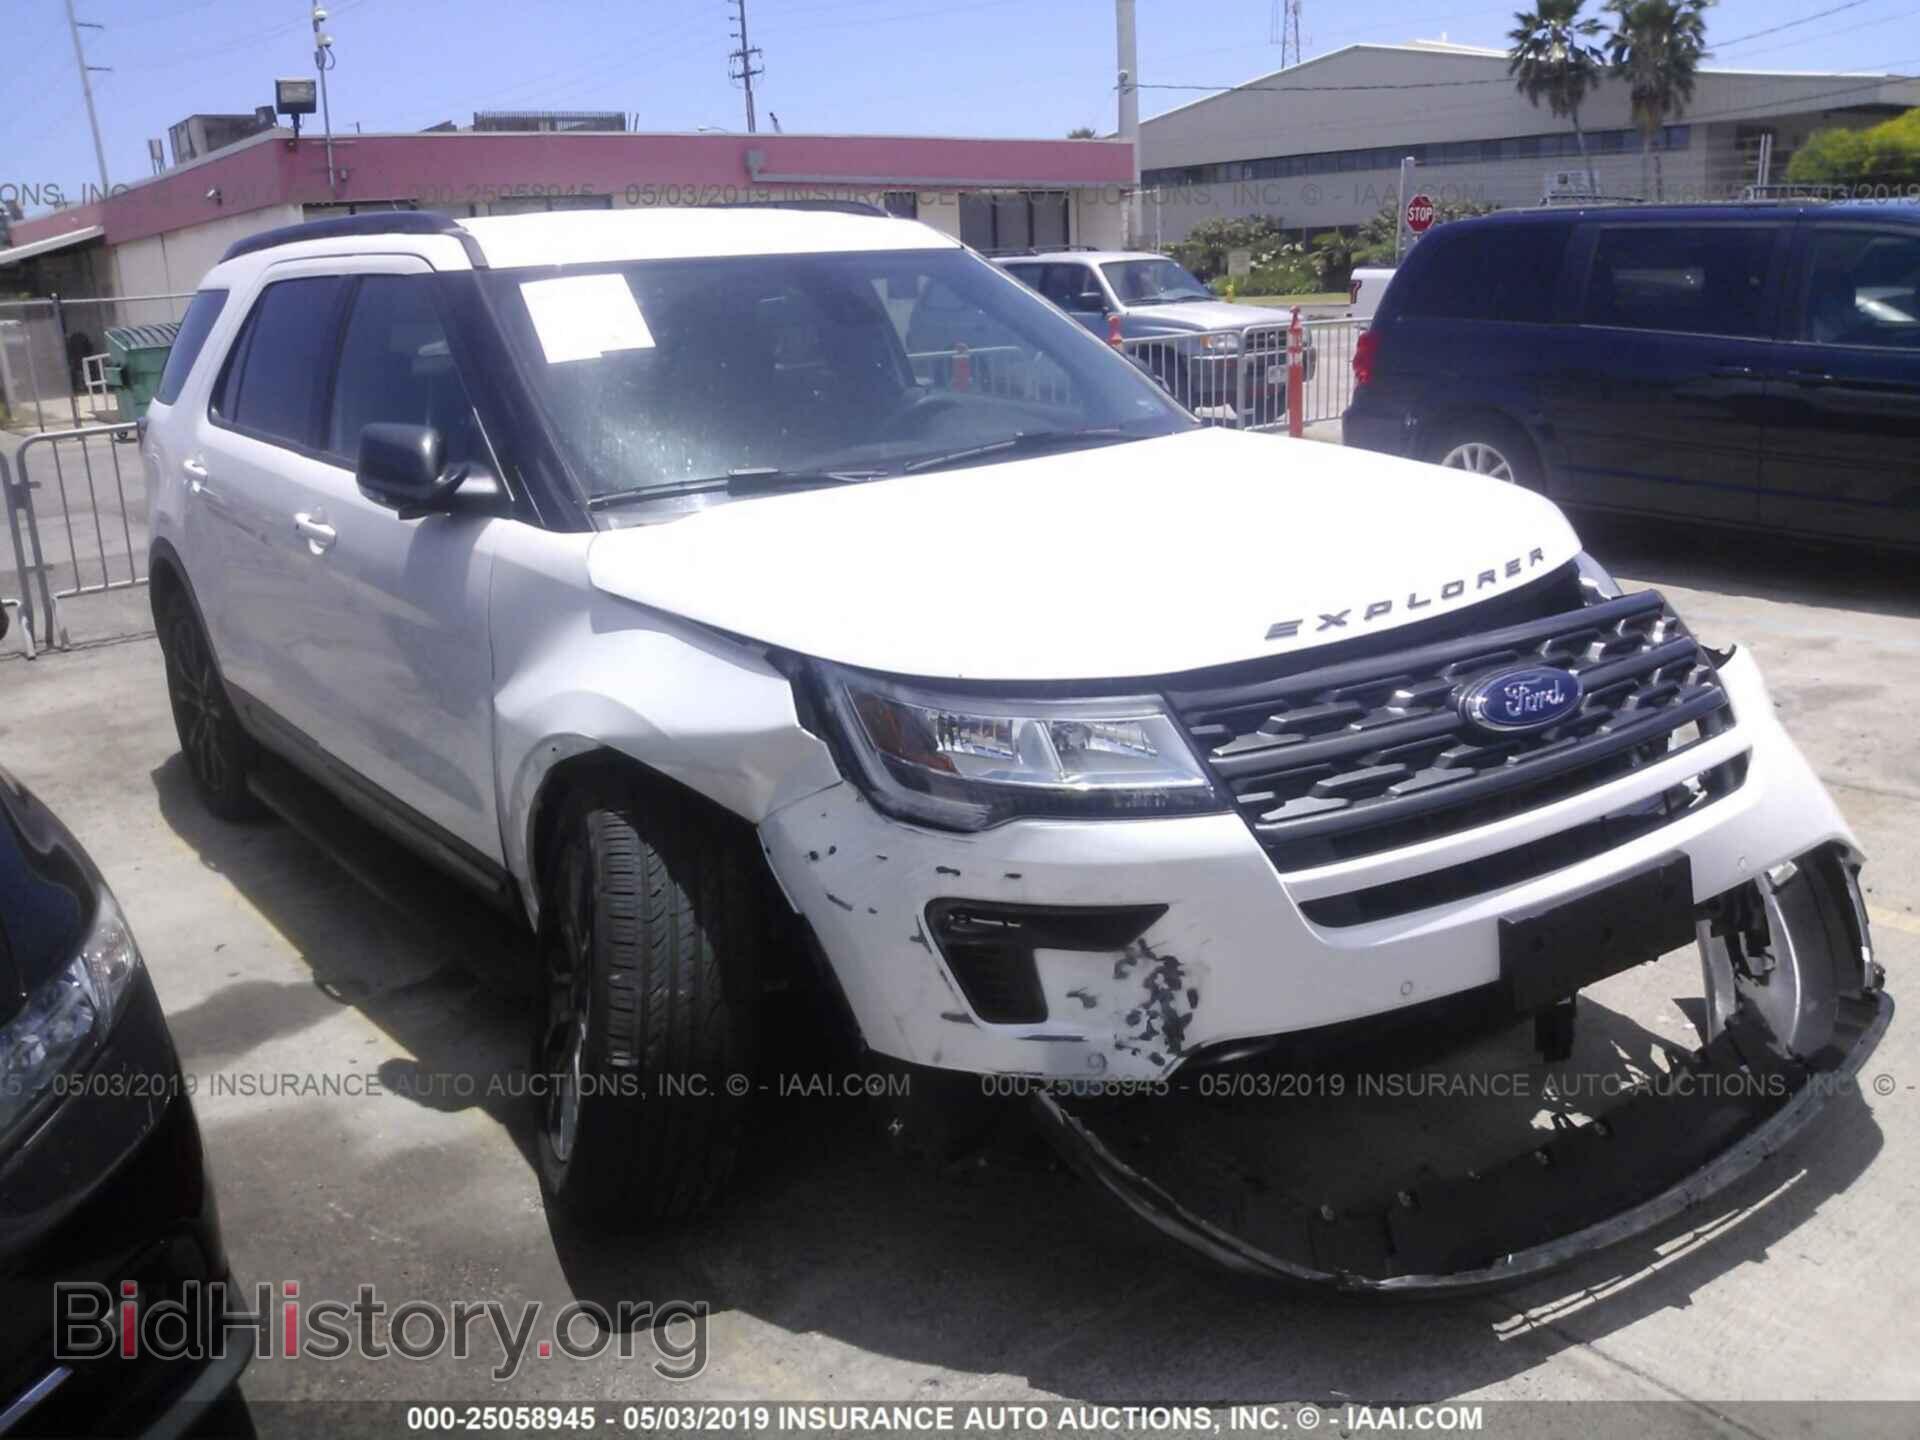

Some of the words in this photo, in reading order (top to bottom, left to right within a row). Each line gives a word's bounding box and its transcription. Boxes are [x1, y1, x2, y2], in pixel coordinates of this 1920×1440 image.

[1408, 207, 1433, 222] STOP
[1264, 547, 1545, 640] EXPLORER
[1504, 678, 1564, 717] Ford
